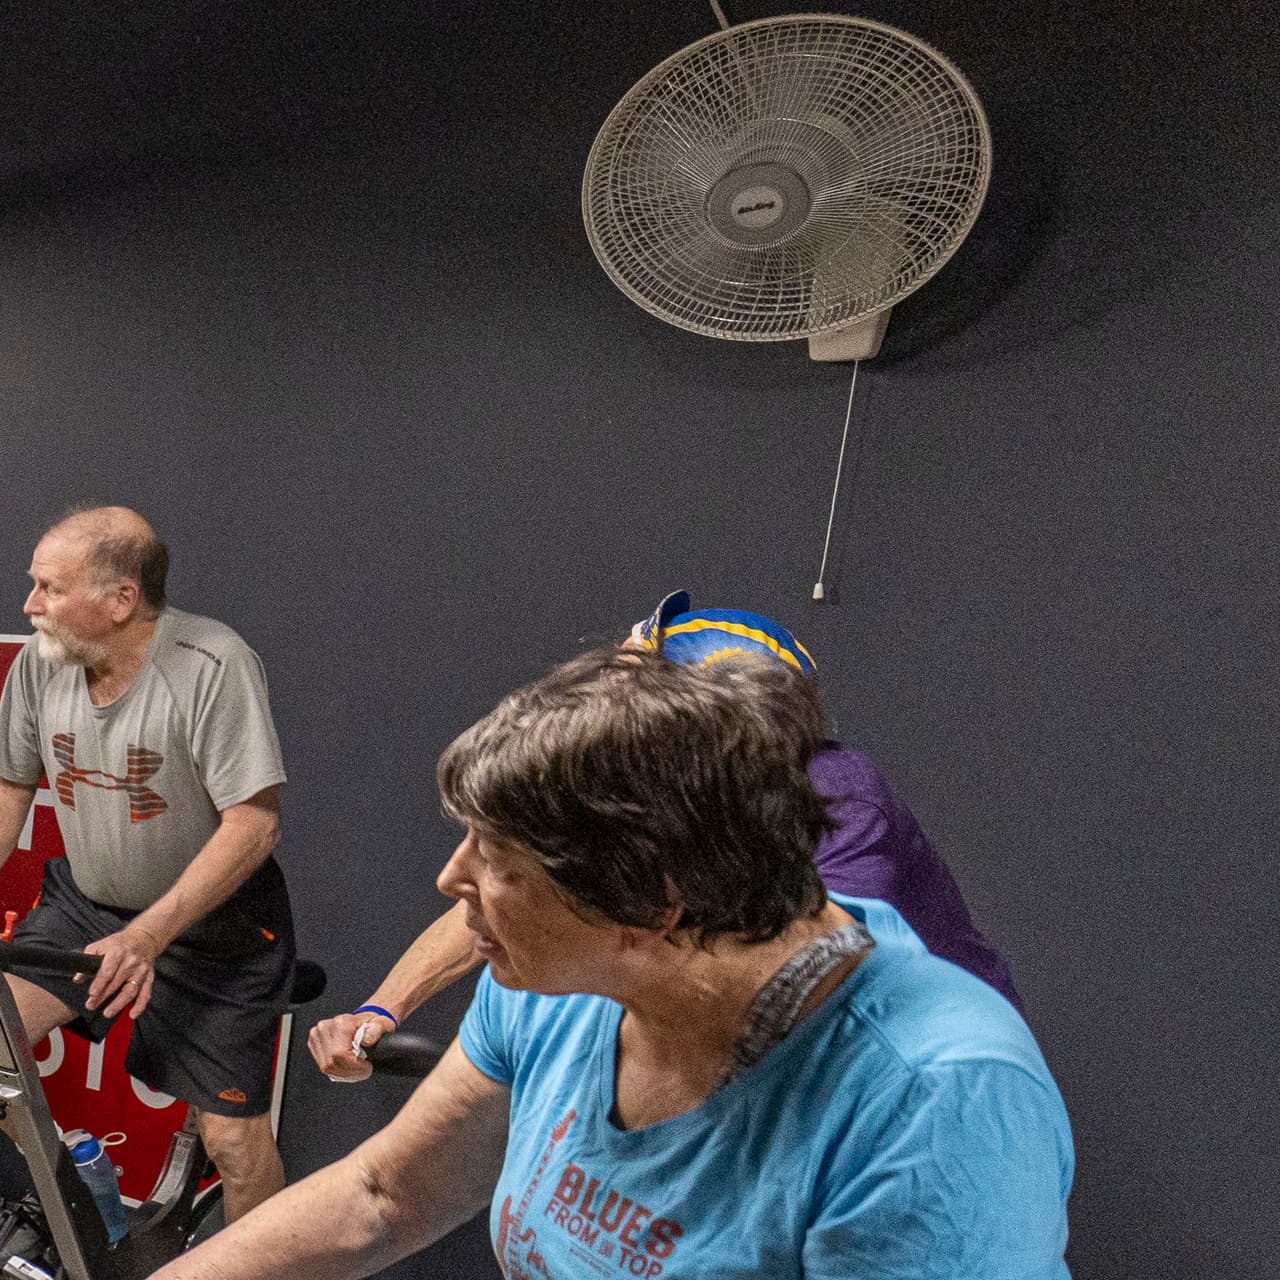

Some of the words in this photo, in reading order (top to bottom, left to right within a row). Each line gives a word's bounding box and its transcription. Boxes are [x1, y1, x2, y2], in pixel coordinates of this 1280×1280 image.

[544, 1197, 600, 1248] FROM
[618, 1246, 663, 1280] TOP
[554, 1162, 684, 1259] BLUES
